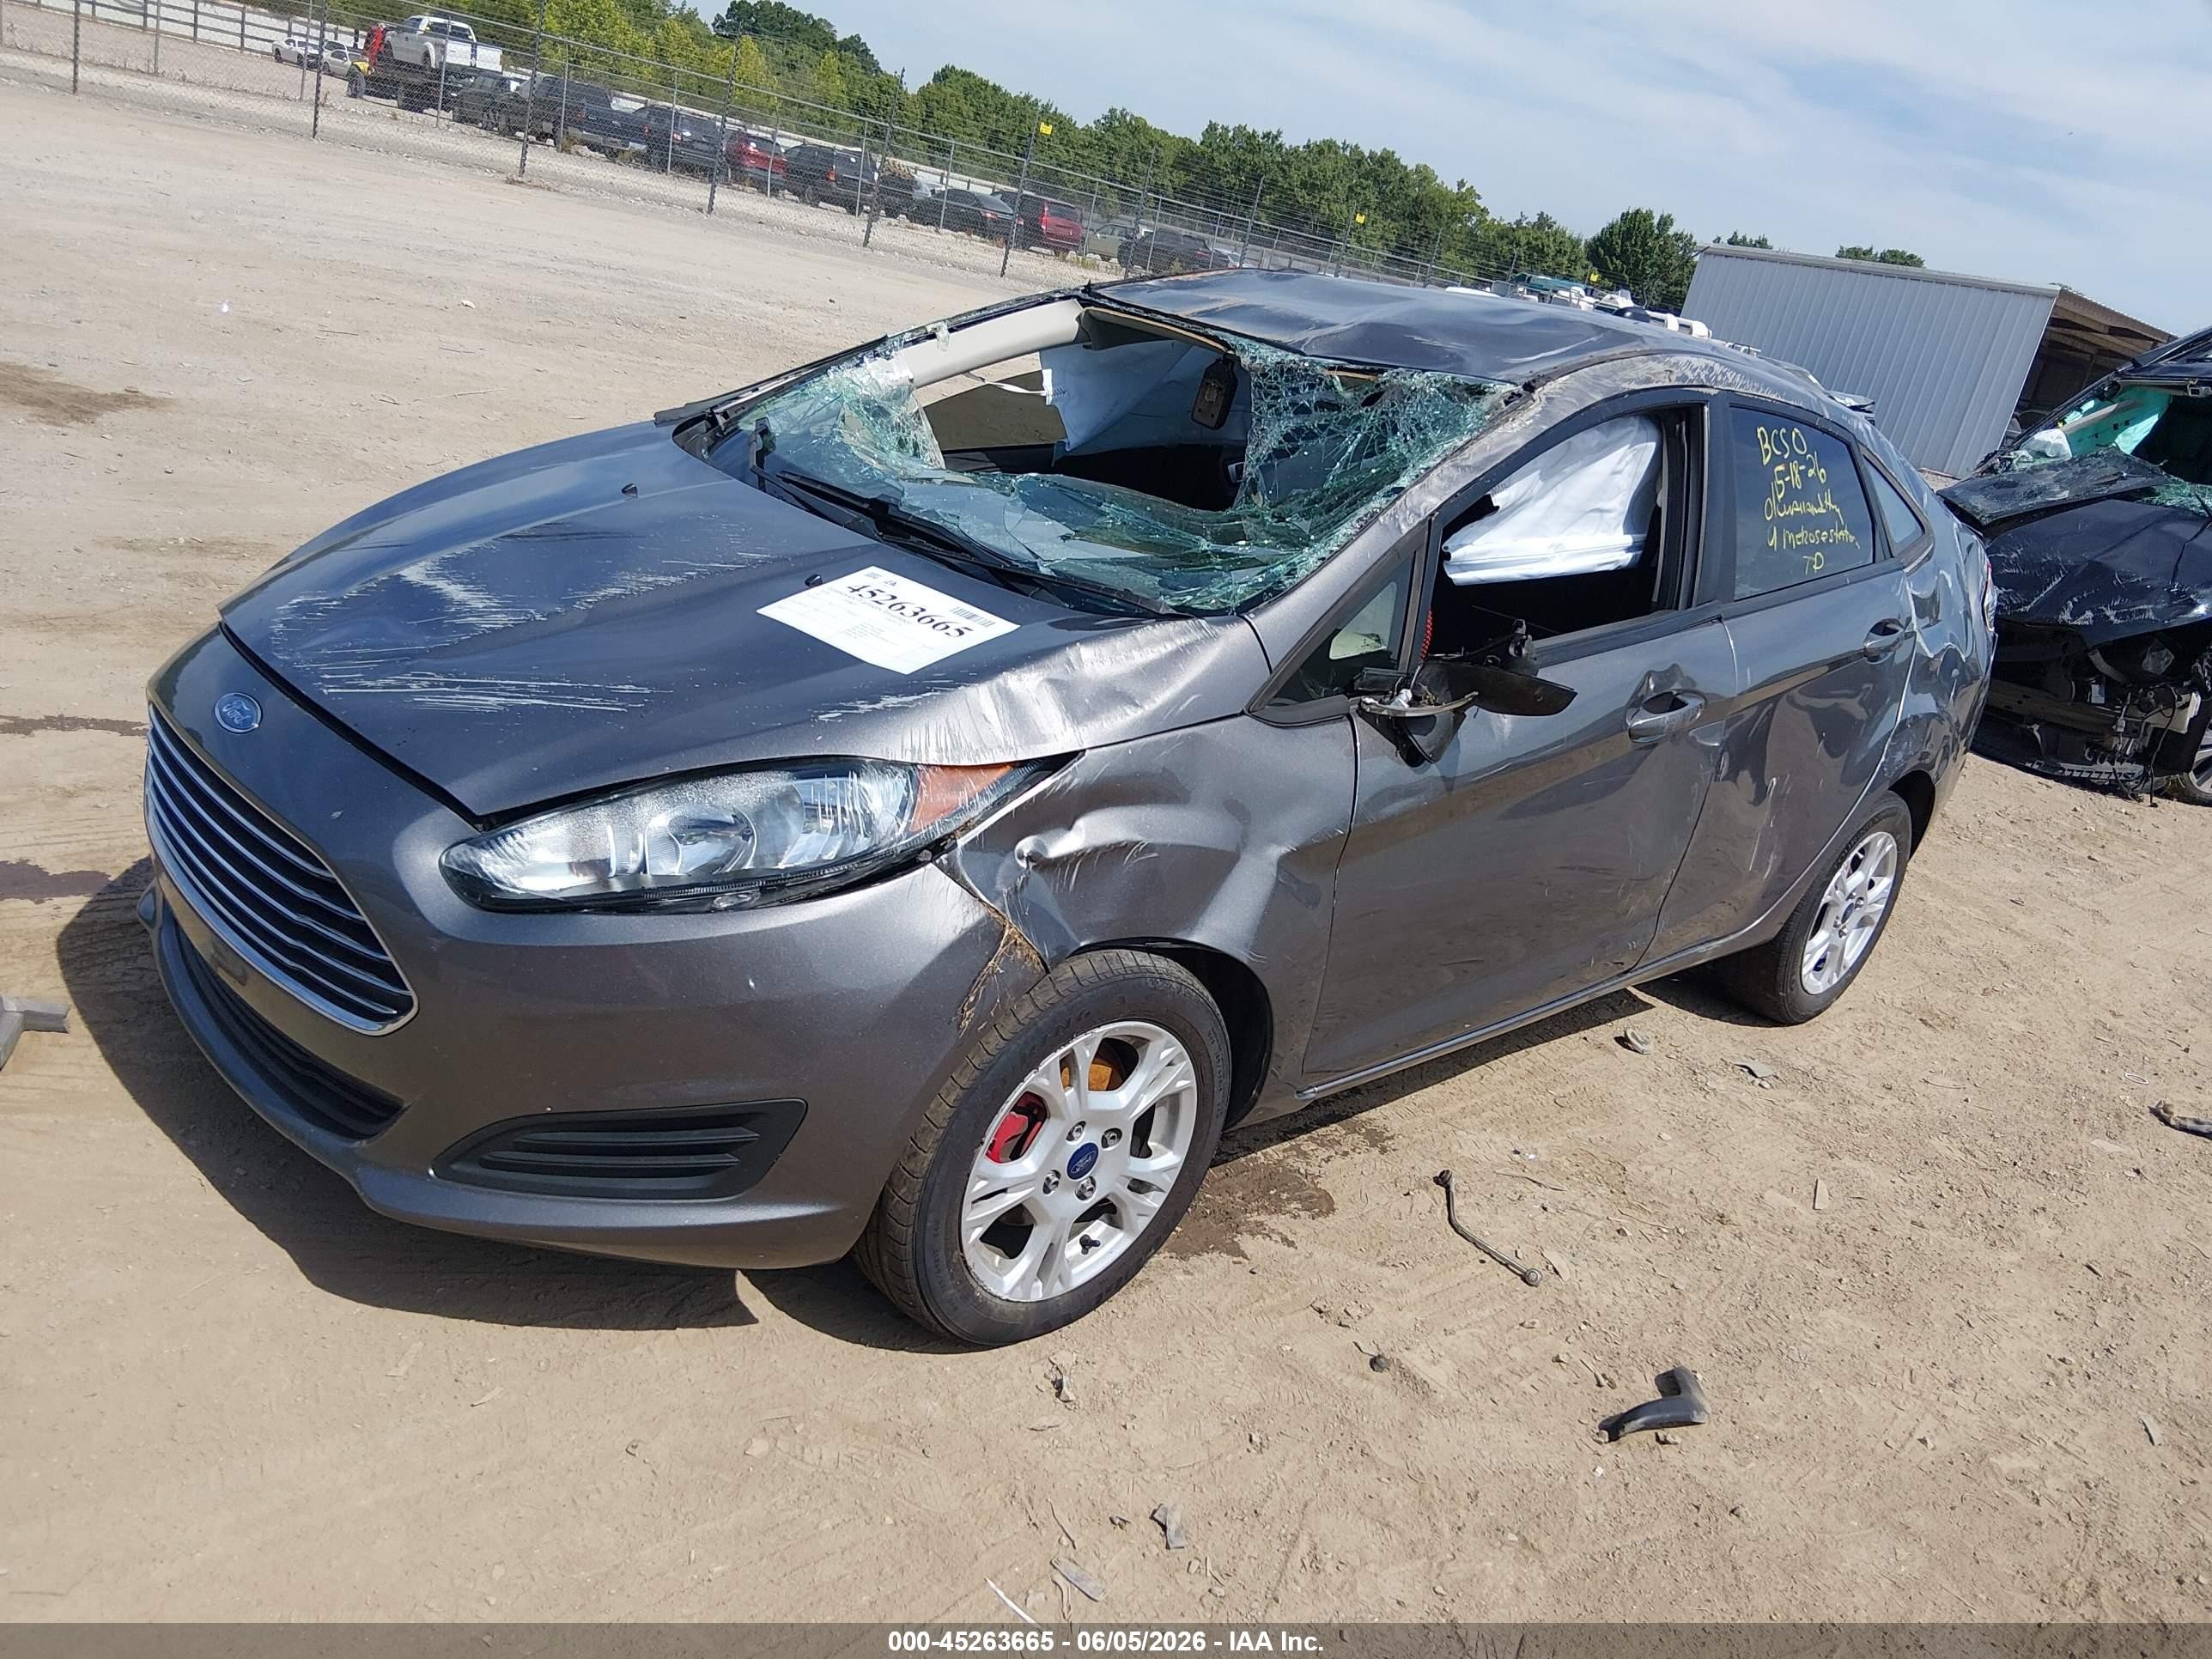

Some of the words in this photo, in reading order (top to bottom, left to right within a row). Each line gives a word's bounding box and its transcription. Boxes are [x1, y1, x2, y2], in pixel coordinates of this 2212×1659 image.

[1757, 426, 1808, 465] BCSO
[1773, 451, 1826, 503] 5-18-26
[847, 585, 973, 638] 45263665
